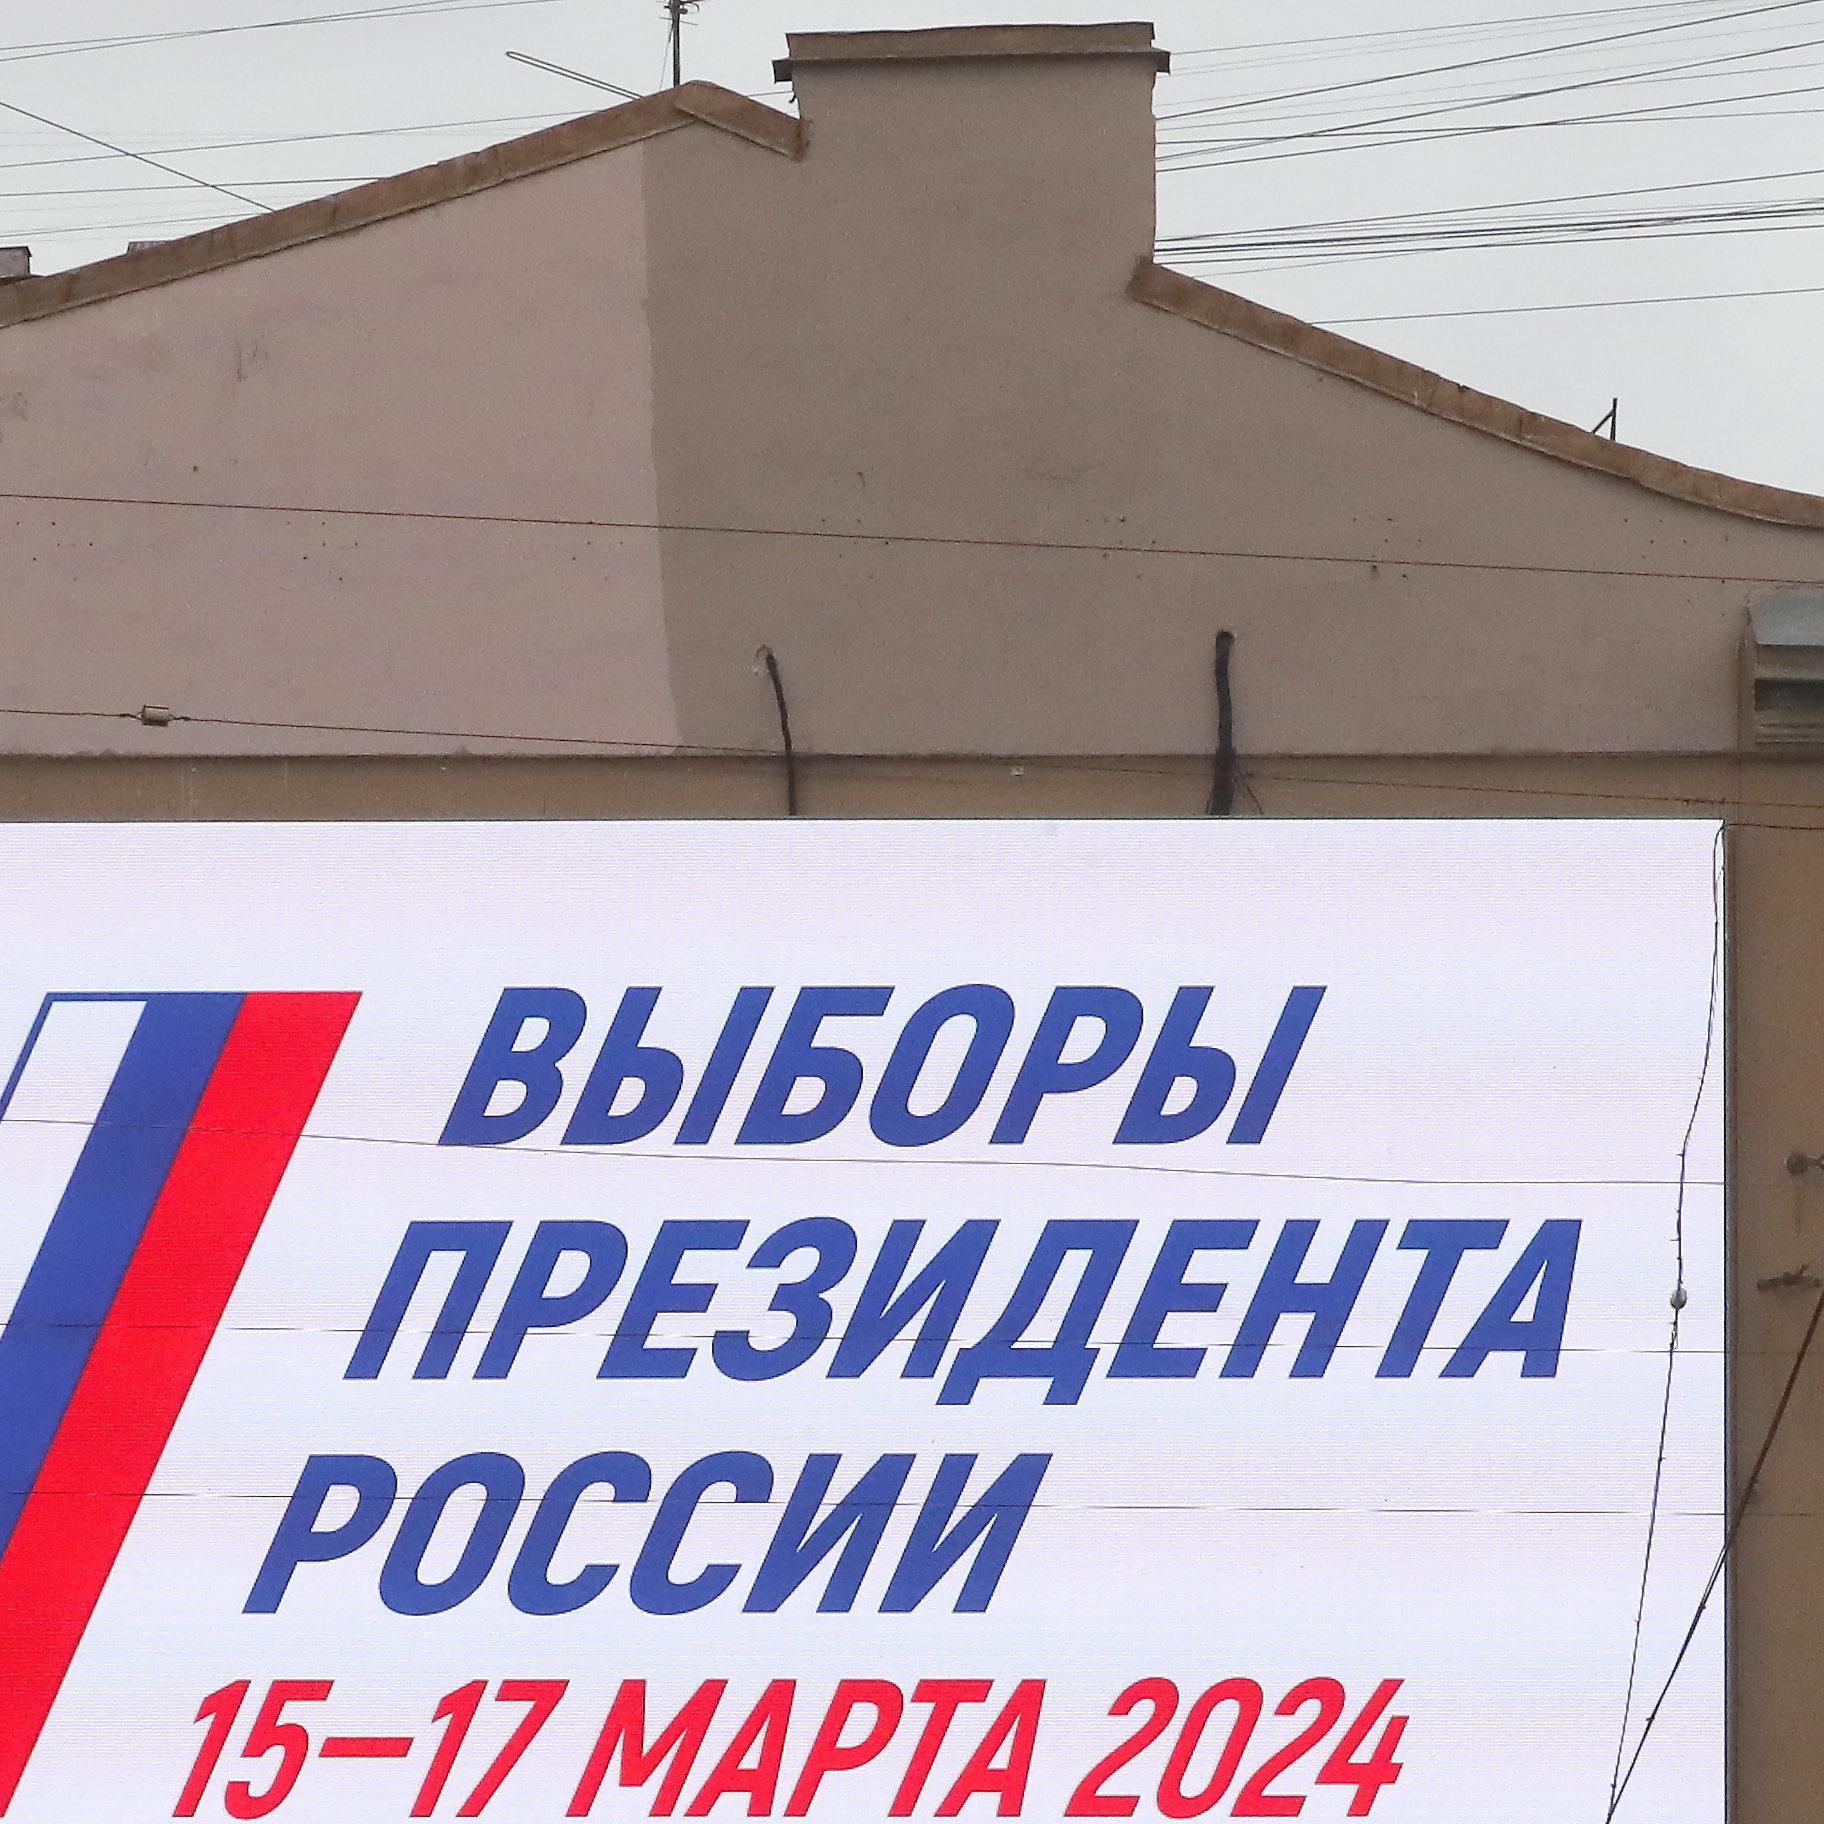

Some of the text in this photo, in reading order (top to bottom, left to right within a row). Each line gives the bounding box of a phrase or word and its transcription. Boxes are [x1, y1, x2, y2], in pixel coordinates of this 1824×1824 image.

[440, 987, 1323, 1143] ВЫБОРЫ
[346, 1219, 1585, 1405] ПРЕЗИДЕНТА
[243, 1453, 1049, 1613] РОССИИ
[568, 1679, 1046, 1818] МАРТА
[1065, 1678, 1409, 1818] 2024
